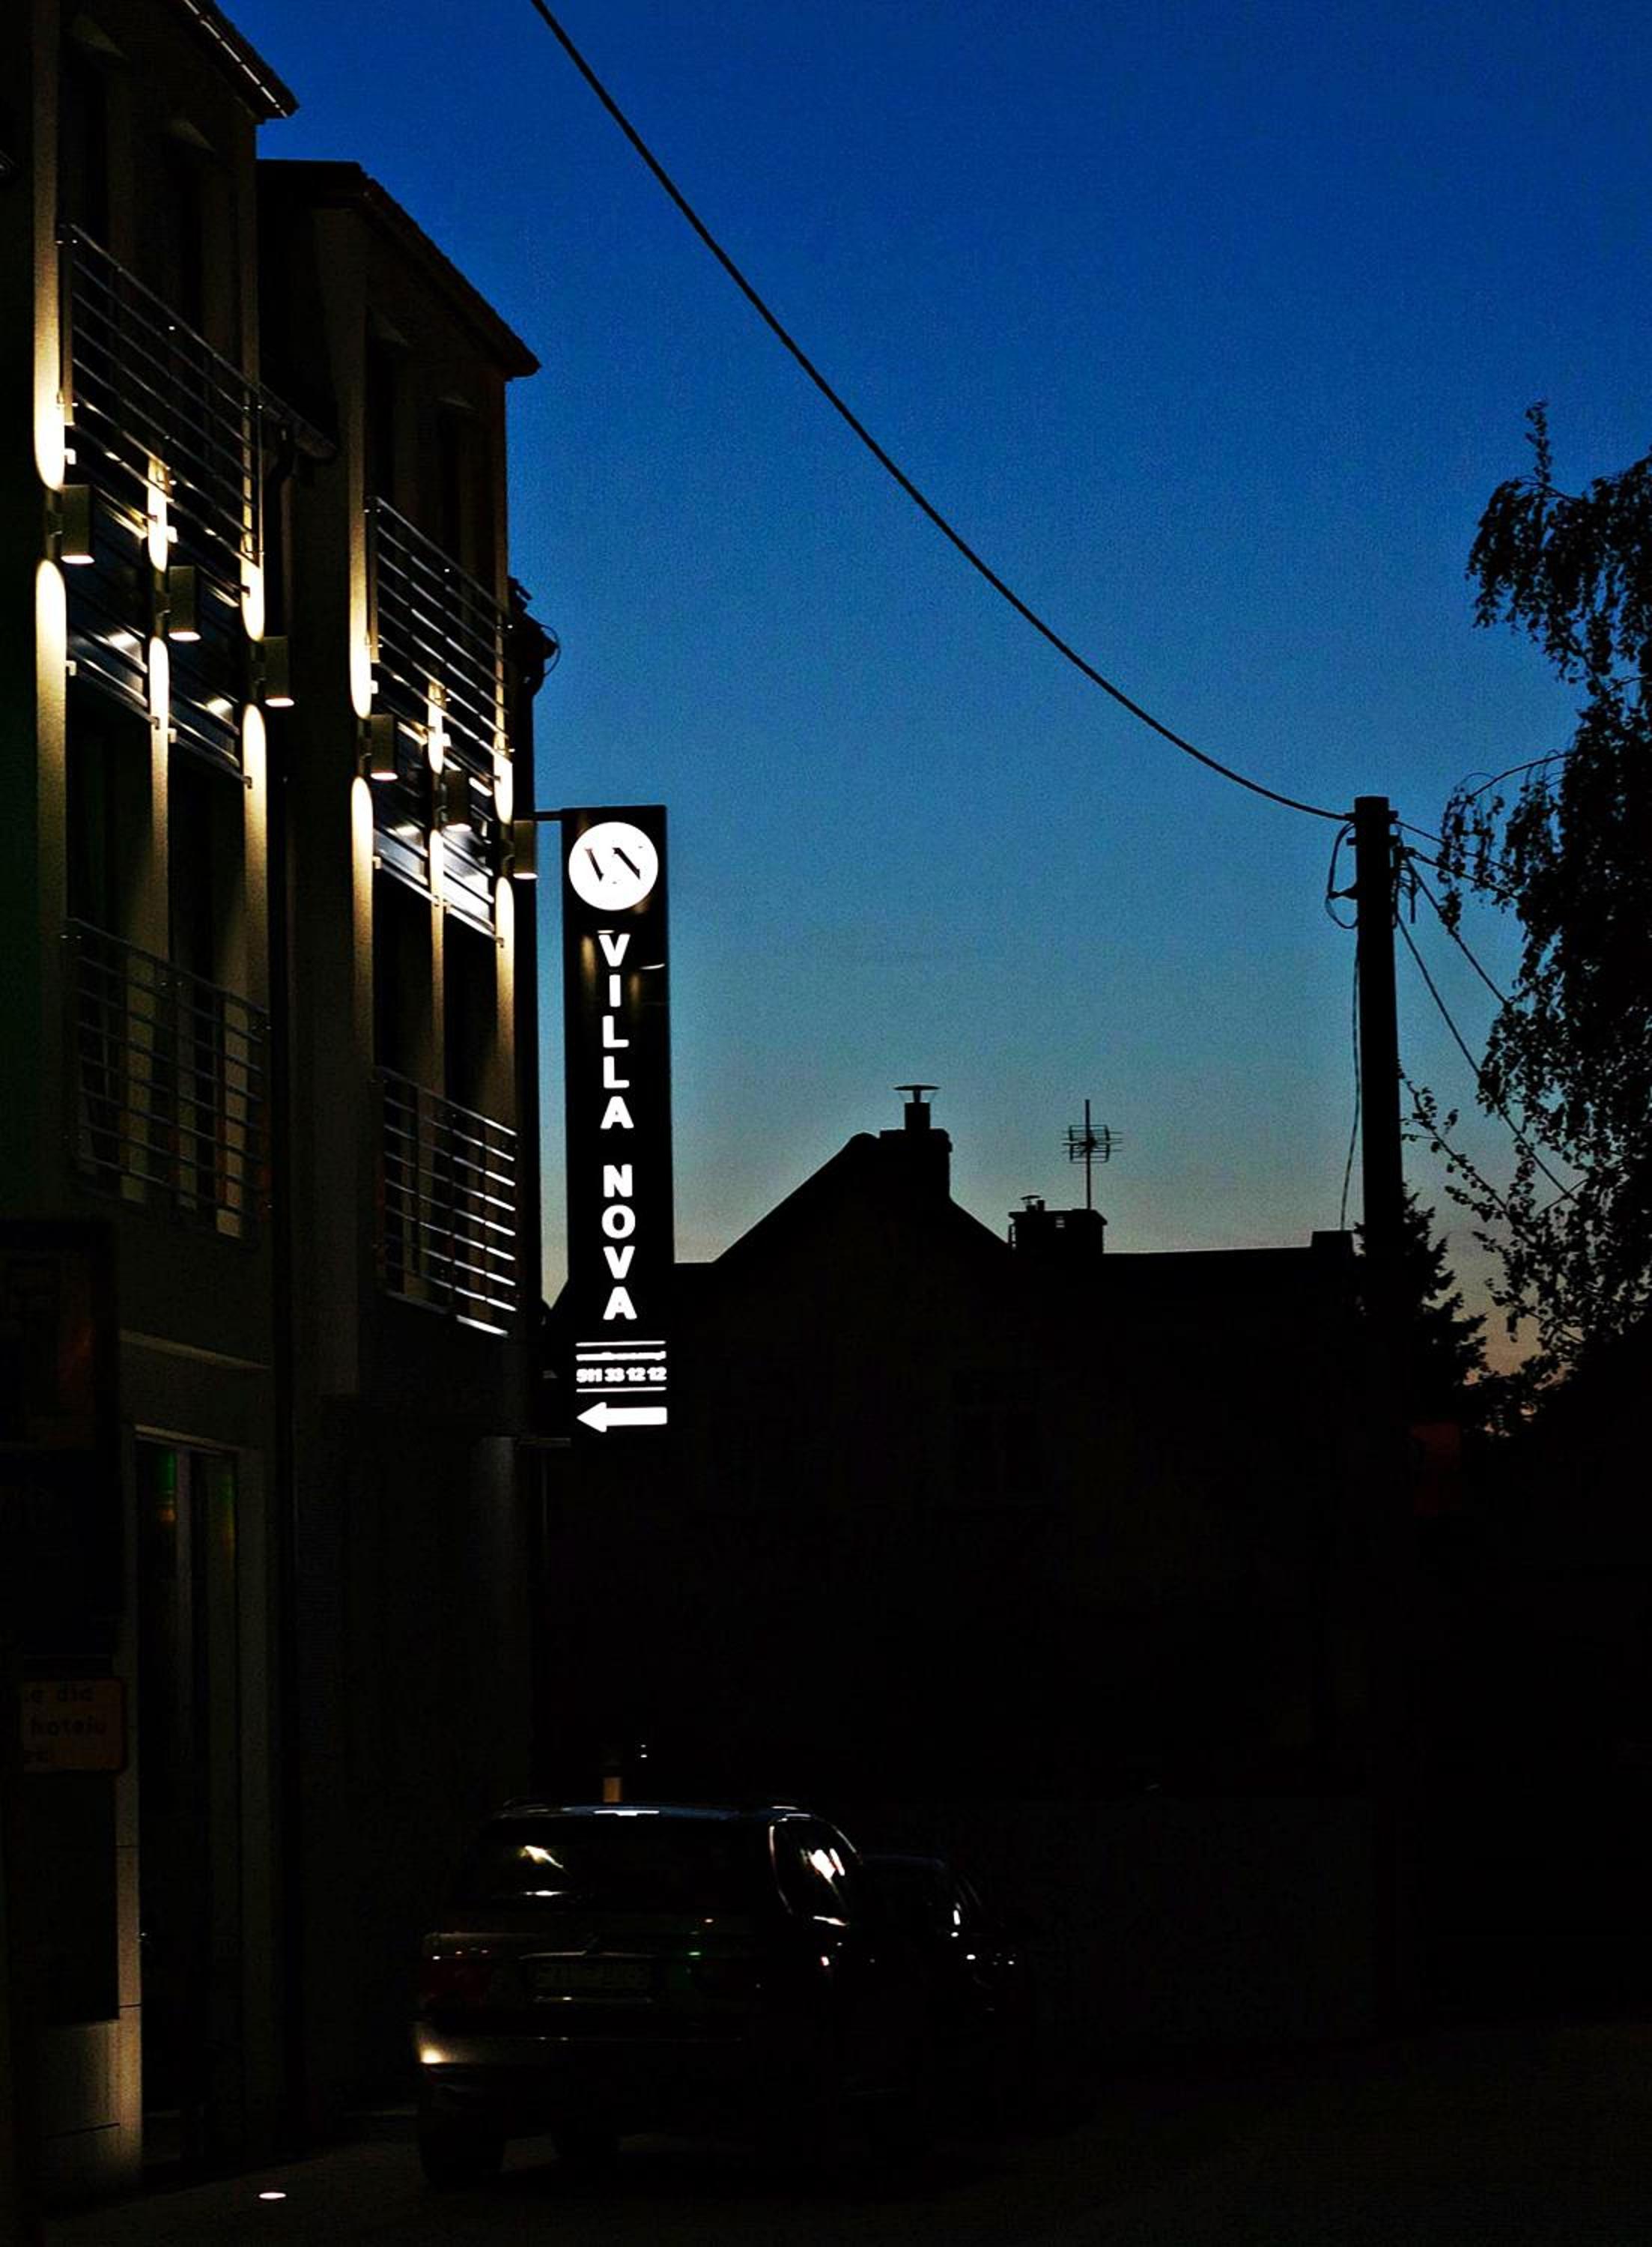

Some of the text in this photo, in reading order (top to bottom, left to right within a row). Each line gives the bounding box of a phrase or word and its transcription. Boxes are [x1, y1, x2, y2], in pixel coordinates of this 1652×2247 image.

[599, 933, 637, 1320] VILLA NOVA
[626, 1367, 646, 1382] 12
[647, 1366, 667, 1381] 12
